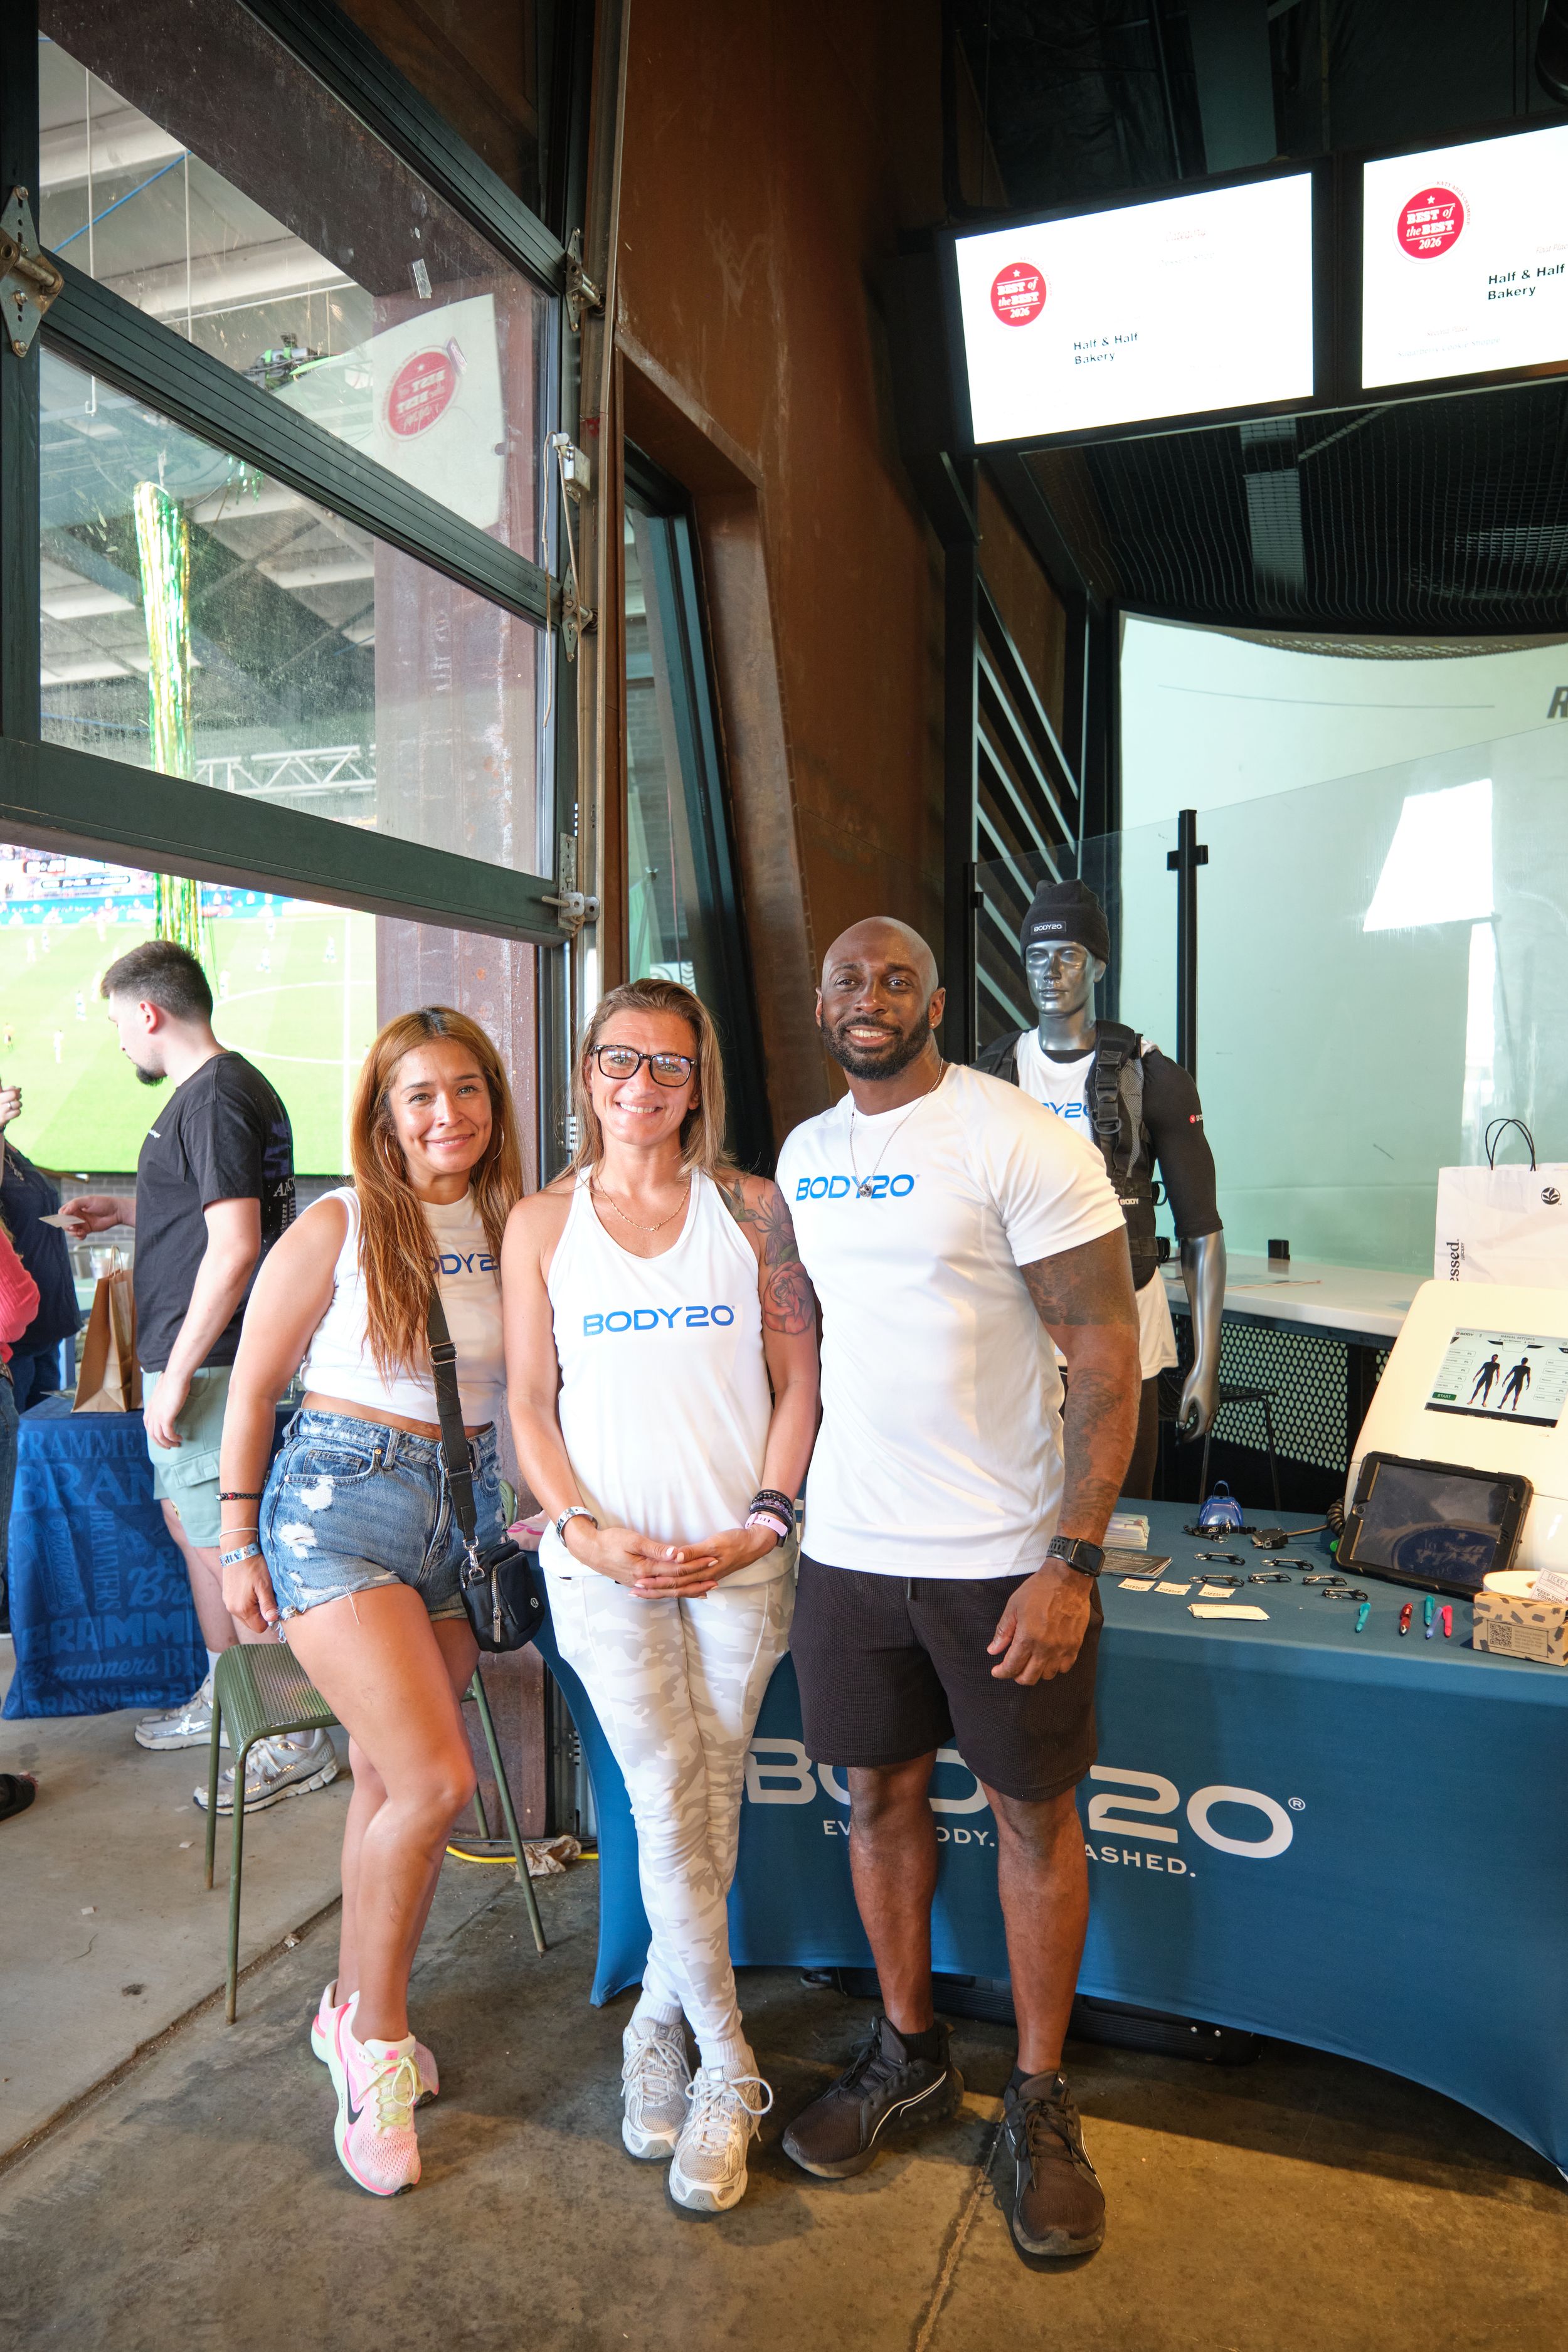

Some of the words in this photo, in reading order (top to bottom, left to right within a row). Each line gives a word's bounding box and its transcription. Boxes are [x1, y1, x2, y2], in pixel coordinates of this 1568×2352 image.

[1406, 209, 1439, 225] BEST
[1443, 204, 1456, 219] of
[1406, 226, 1421, 237] the
[1421, 220, 1454, 235] BEST
[1418, 236, 1442, 250] 2026
[1489, 271, 1516, 285] Half
[1522, 269, 1531, 280] &
[1536, 263, 1565, 278] Half
[997, 281, 1026, 295] BEST
[1027, 276, 1039, 291] of
[1488, 286, 1536, 300] Bakery
[998, 297, 1011, 307] the
[1010, 291, 1039, 305] BEST
[1010, 307, 1030, 319] 2026
[1073, 339, 1096, 351] Half
[1102, 337, 1110, 346] &
[1115, 332, 1138, 344] Half
[1074, 352, 1115, 364] Bakery
[1034, 924, 1062, 932] BODY20
[1042, 1102, 1090, 1118] Y2
[796, 1174, 914, 1201] BODY20
[583, 1305, 734, 1337] BODY20
[1547, 1573, 1568, 1587] TICKET
[1537, 1588, 1550, 1597] KEEP
[1551, 1595, 1563, 1604] THIS
